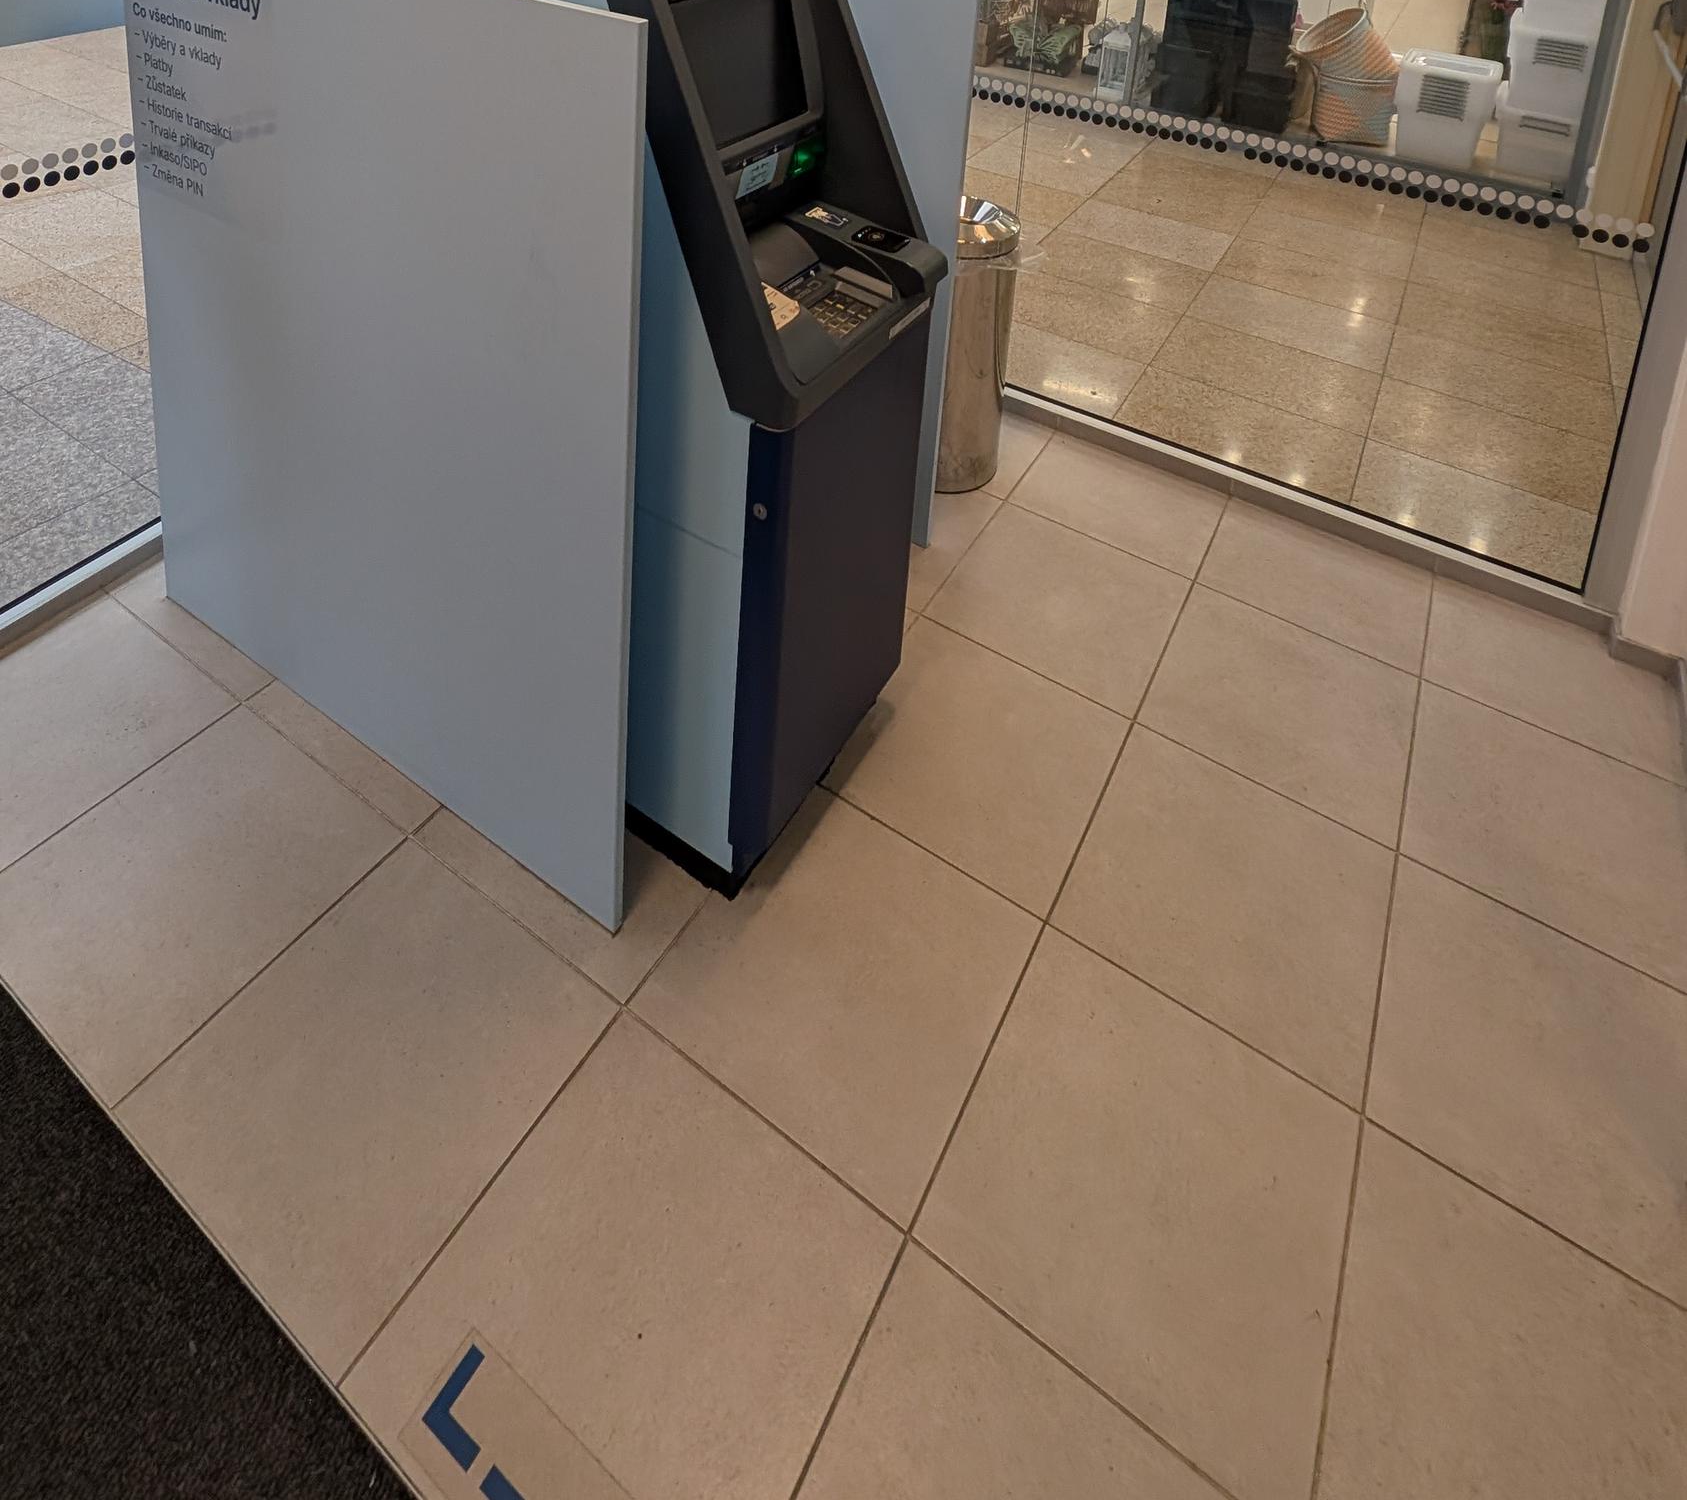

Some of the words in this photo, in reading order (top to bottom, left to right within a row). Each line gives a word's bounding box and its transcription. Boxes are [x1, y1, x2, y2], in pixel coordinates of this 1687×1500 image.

[132, 2, 146, 18] Co
[149, 8, 191, 31] všechno
[142, 29, 176, 56] Výběry
[179, 44, 186, 56] a
[189, 46, 222, 70] vklady
[144, 52, 173, 77] Platby
[145, 75, 187, 101] Zůstatek
[147, 97, 183, 123] Historie
[186, 112, 232, 141] transakcí
[148, 120, 177, 142] Trvalé
[180, 133, 215, 160] příkazy
[150, 141, 207, 176] Inkaso/SIPO
[152, 164, 183, 188] Změna
[186, 178, 203, 197] PIN
